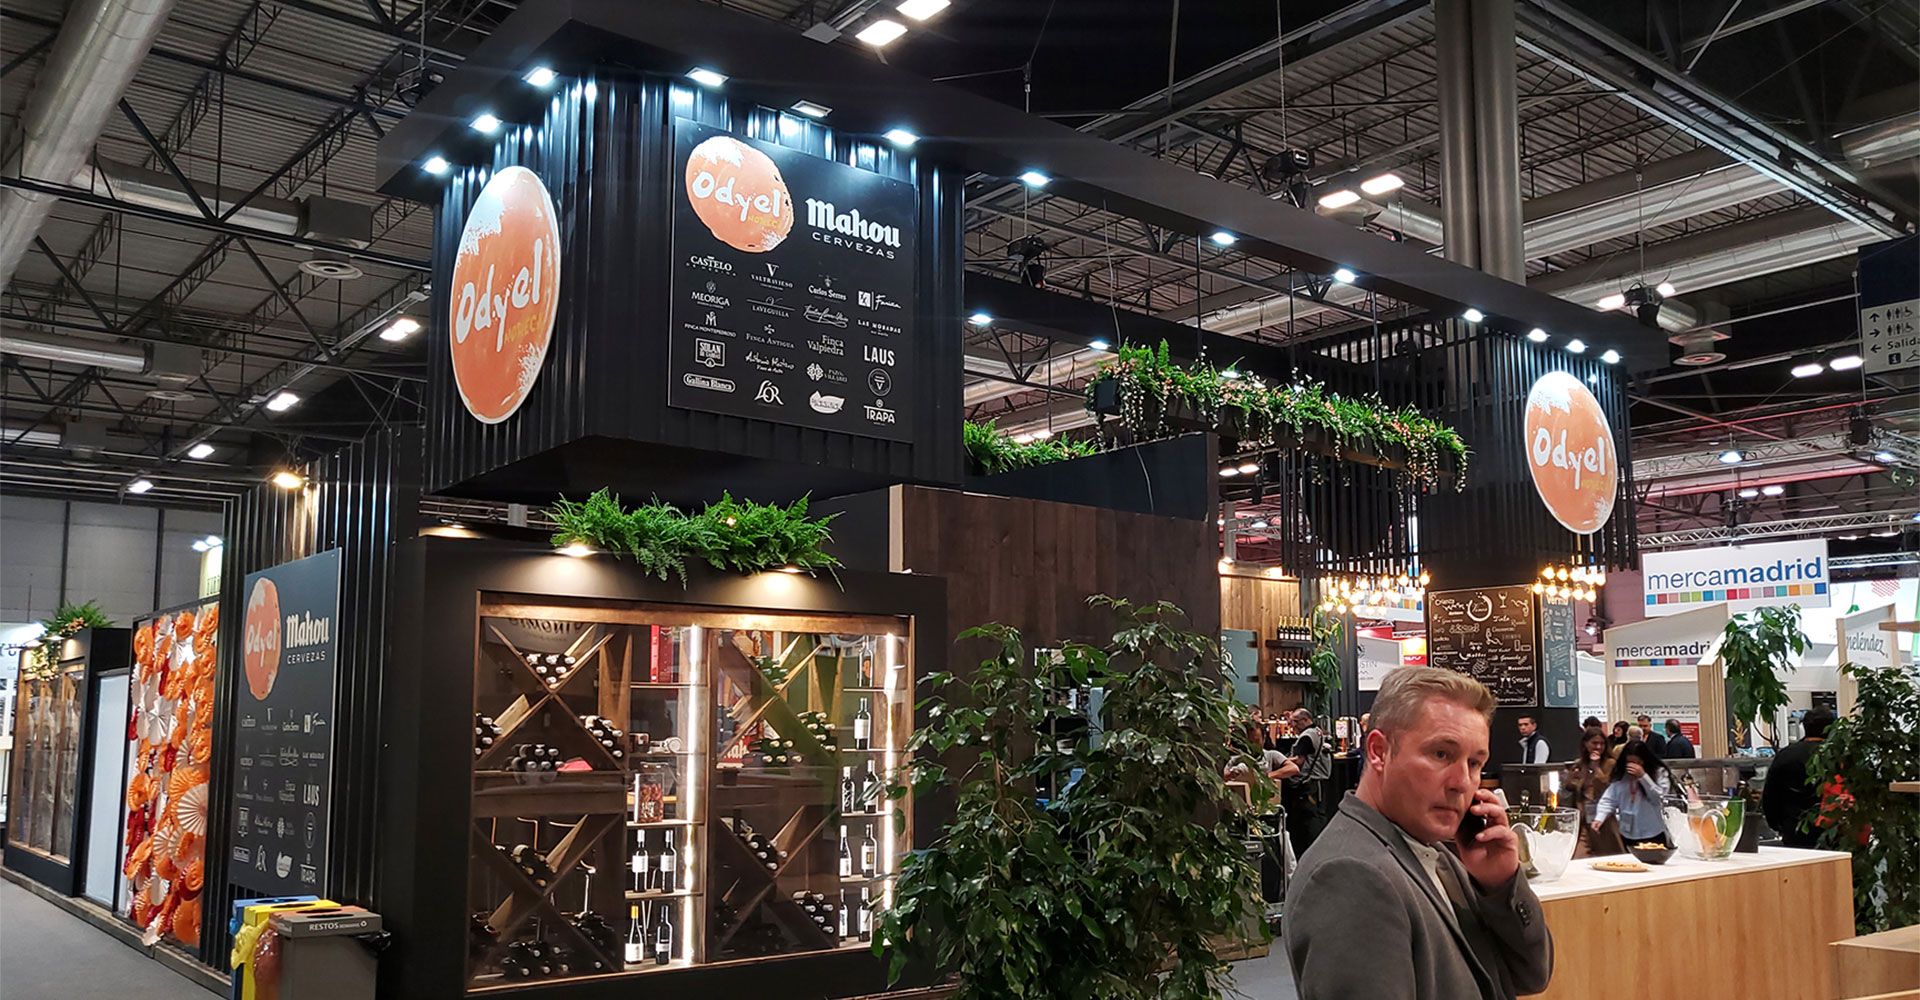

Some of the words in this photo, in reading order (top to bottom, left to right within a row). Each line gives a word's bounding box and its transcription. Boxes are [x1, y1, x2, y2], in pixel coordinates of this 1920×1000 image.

[692, 171, 779, 222] Odyel
[805, 197, 901, 249] Mahou
[812, 231, 895, 260] CERVEZAS
[690, 255, 733, 272] CASTELO
[456, 238, 542, 352] Odyel
[691, 291, 730, 307] MEORIGA
[808, 285, 828, 297] Carlos
[858, 319, 870, 327] LAS
[746, 333, 765, 344] FINCA
[766, 336, 795, 349] ANTIGUA
[807, 340, 845, 356] Valpiedra
[822, 335, 844, 347] Finca
[863, 344, 896, 367] LAUS
[686, 375, 710, 387] Gallina
[711, 379, 732, 391] Blanca
[863, 405, 896, 424] TRAPA
[1533, 427, 1606, 490] Odyel
[1648, 556, 1822, 590] mercamadrid
[285, 609, 331, 649] Mahou
[246, 618, 279, 669] Odyel
[1616, 641, 1711, 658] mercamadri
[286, 650, 327, 665] CERVEZAS
[303, 783, 320, 806] LAUS
[309, 922, 339, 931] RESTOS
